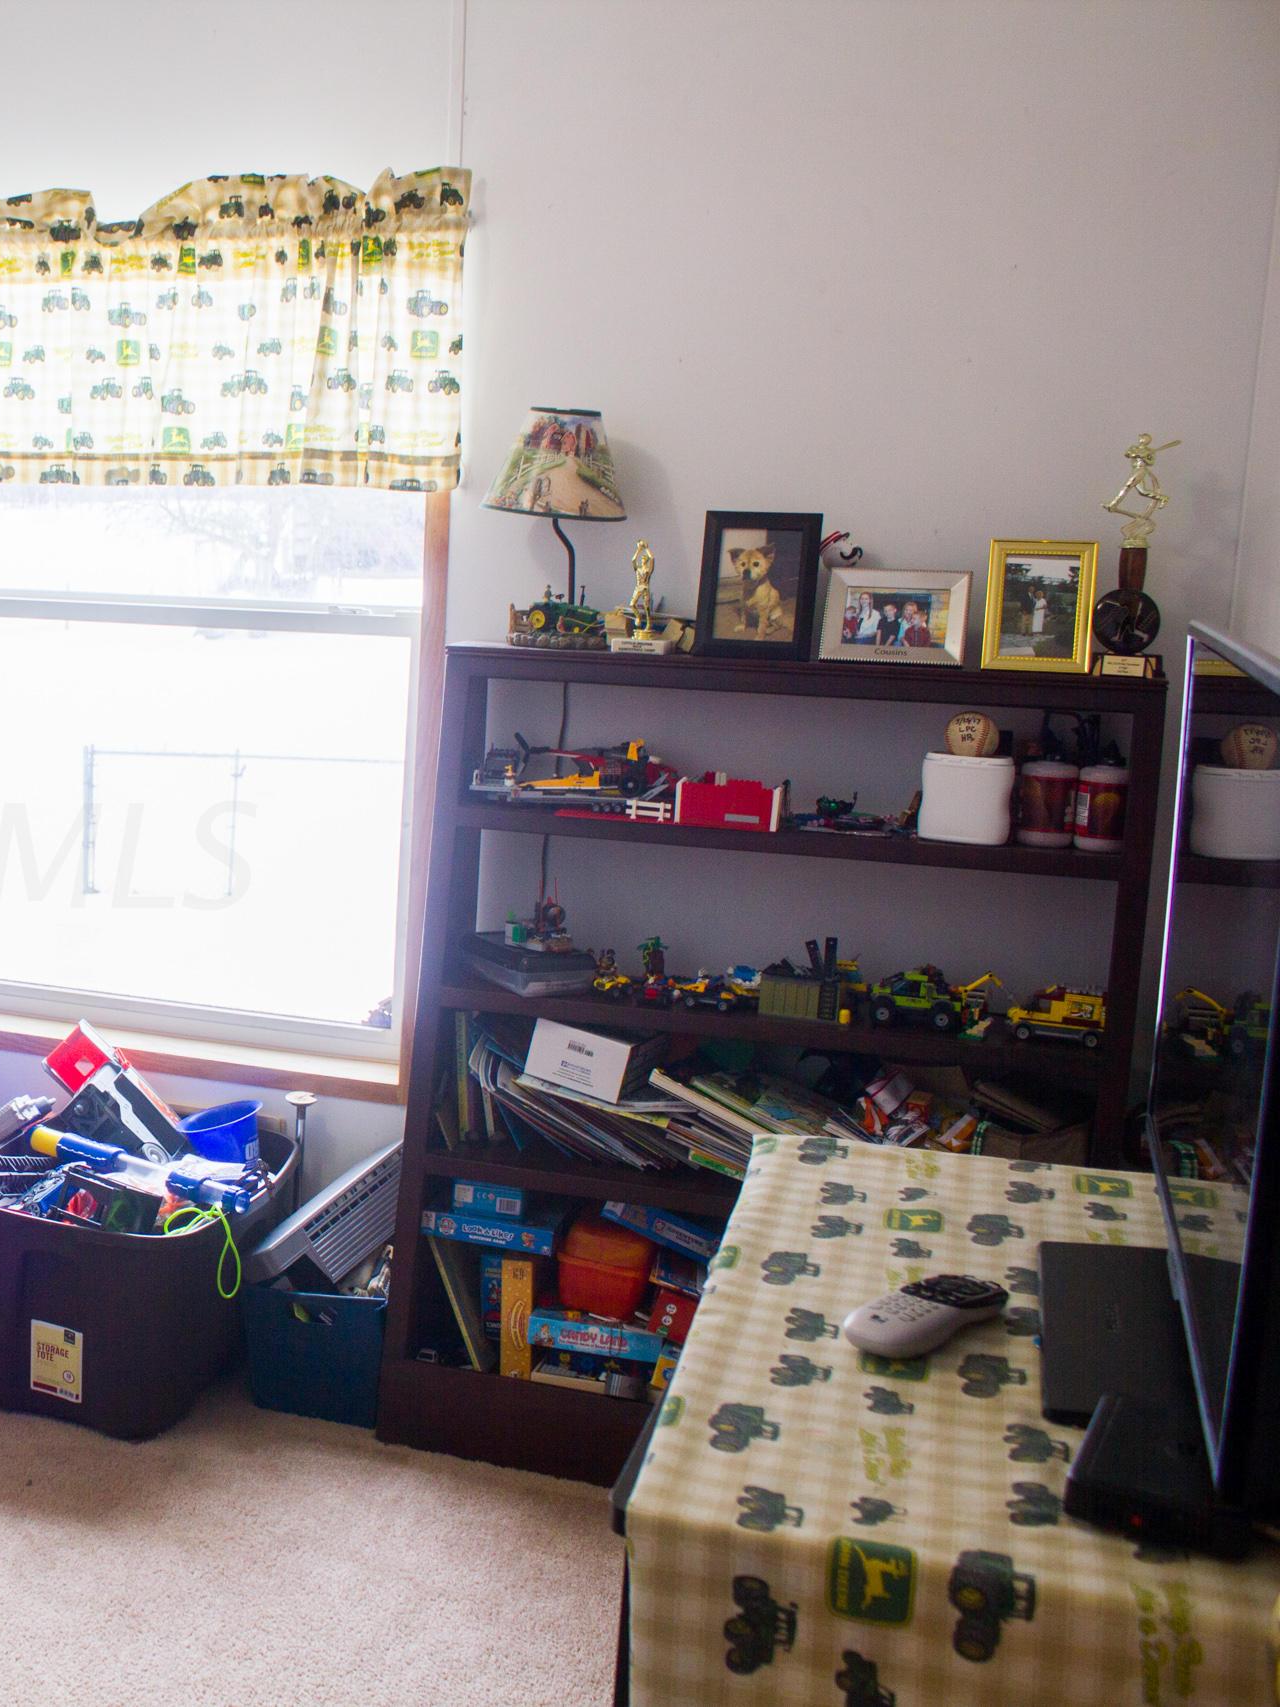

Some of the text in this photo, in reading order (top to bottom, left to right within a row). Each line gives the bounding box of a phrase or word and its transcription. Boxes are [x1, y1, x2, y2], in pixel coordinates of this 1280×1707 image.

[874, 647, 908, 656] Cousins
[561, 1328, 598, 1344] CANDY
[600, 1333, 629, 1347] LAND
[36, 1342, 70, 1359] STORAGE
[36, 1350, 55, 1362] TOTE
